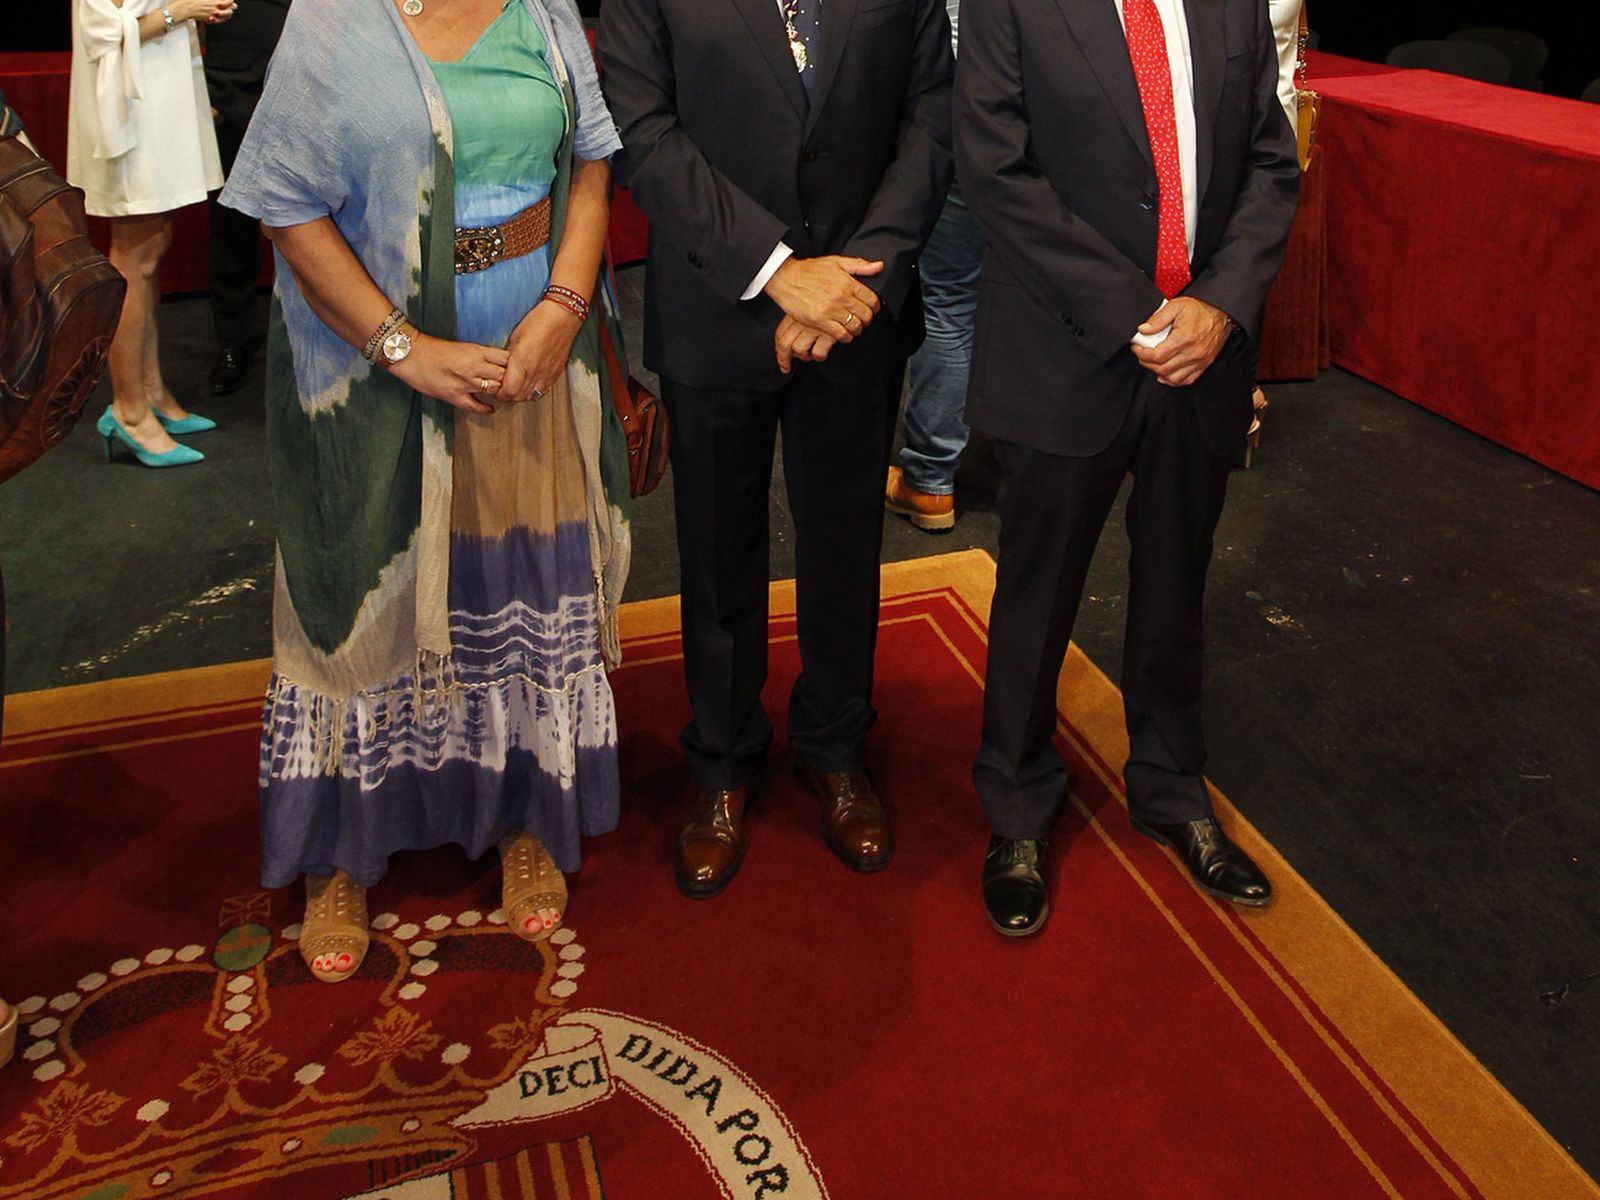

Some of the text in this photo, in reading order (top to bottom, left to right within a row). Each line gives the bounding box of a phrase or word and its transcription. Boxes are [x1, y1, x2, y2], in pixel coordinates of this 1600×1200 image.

[519, 1033, 789, 1200] DECI DIDA POR
